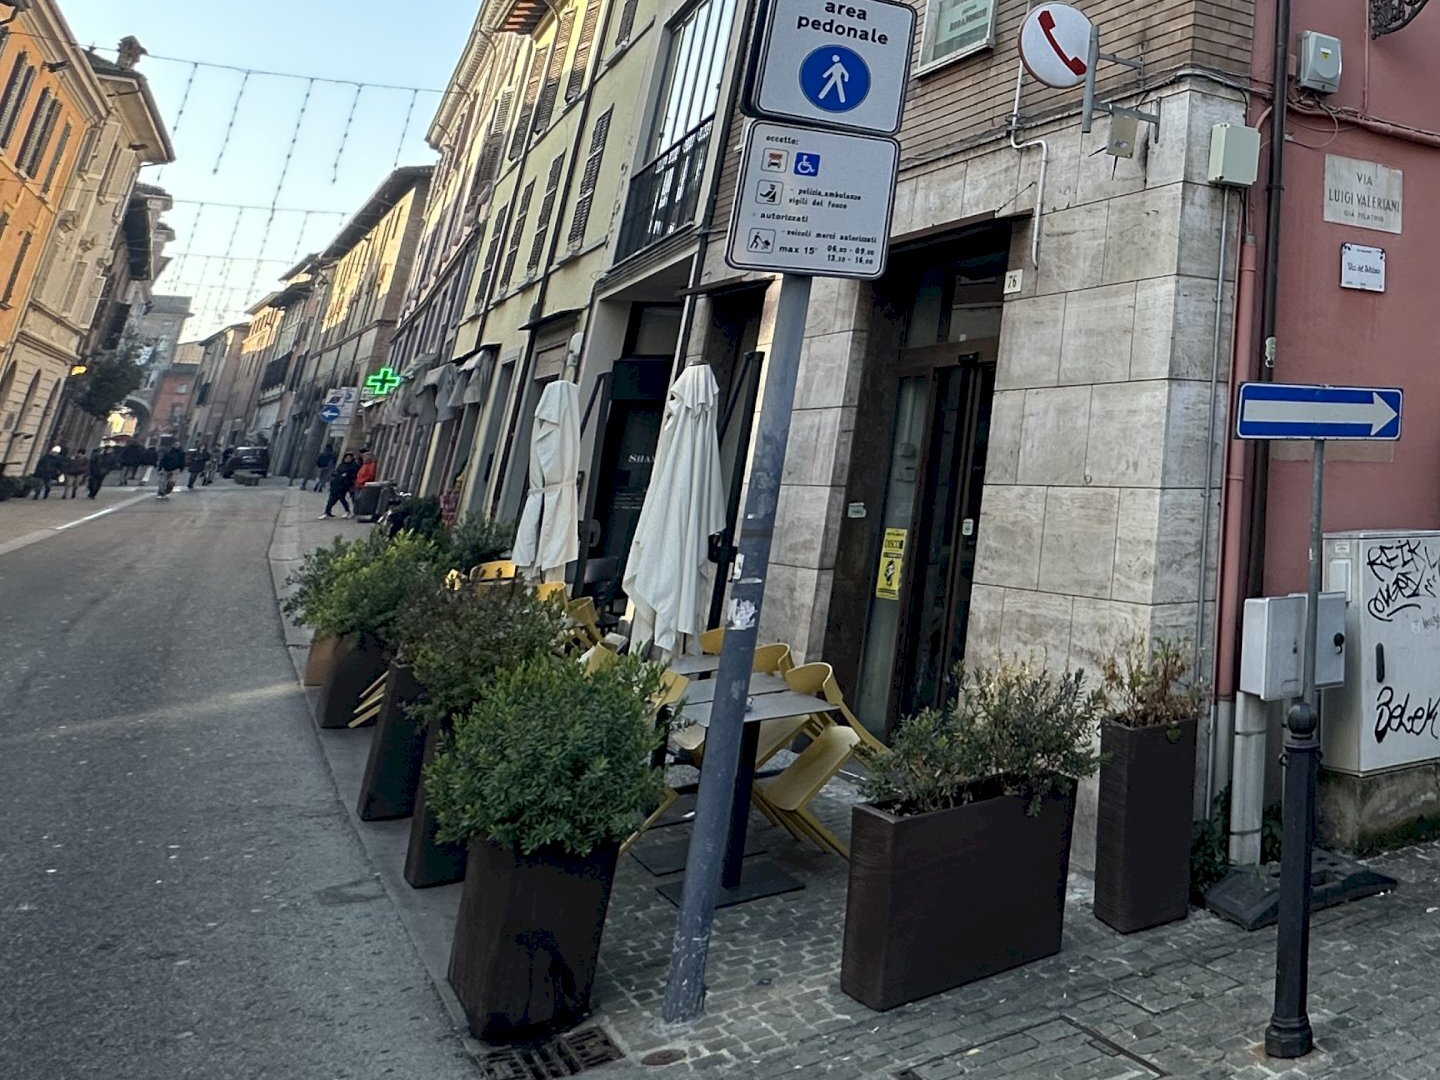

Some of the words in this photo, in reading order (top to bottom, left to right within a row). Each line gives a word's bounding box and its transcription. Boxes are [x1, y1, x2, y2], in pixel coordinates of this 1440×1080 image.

[824, 1, 867, 21] area
[796, 15, 889, 45] pedonale
[1356, 172, 1373, 186] VIA
[788, 197, 808, 206] vigili
[812, 199, 823, 208] del
[1328, 188, 1354, 205] LUIGI
[1356, 193, 1401, 213] VALERIANI
[760, 212, 809, 223] autorizzati
[779, 245, 800, 254] max
[1007, 274, 1018, 289] 76
